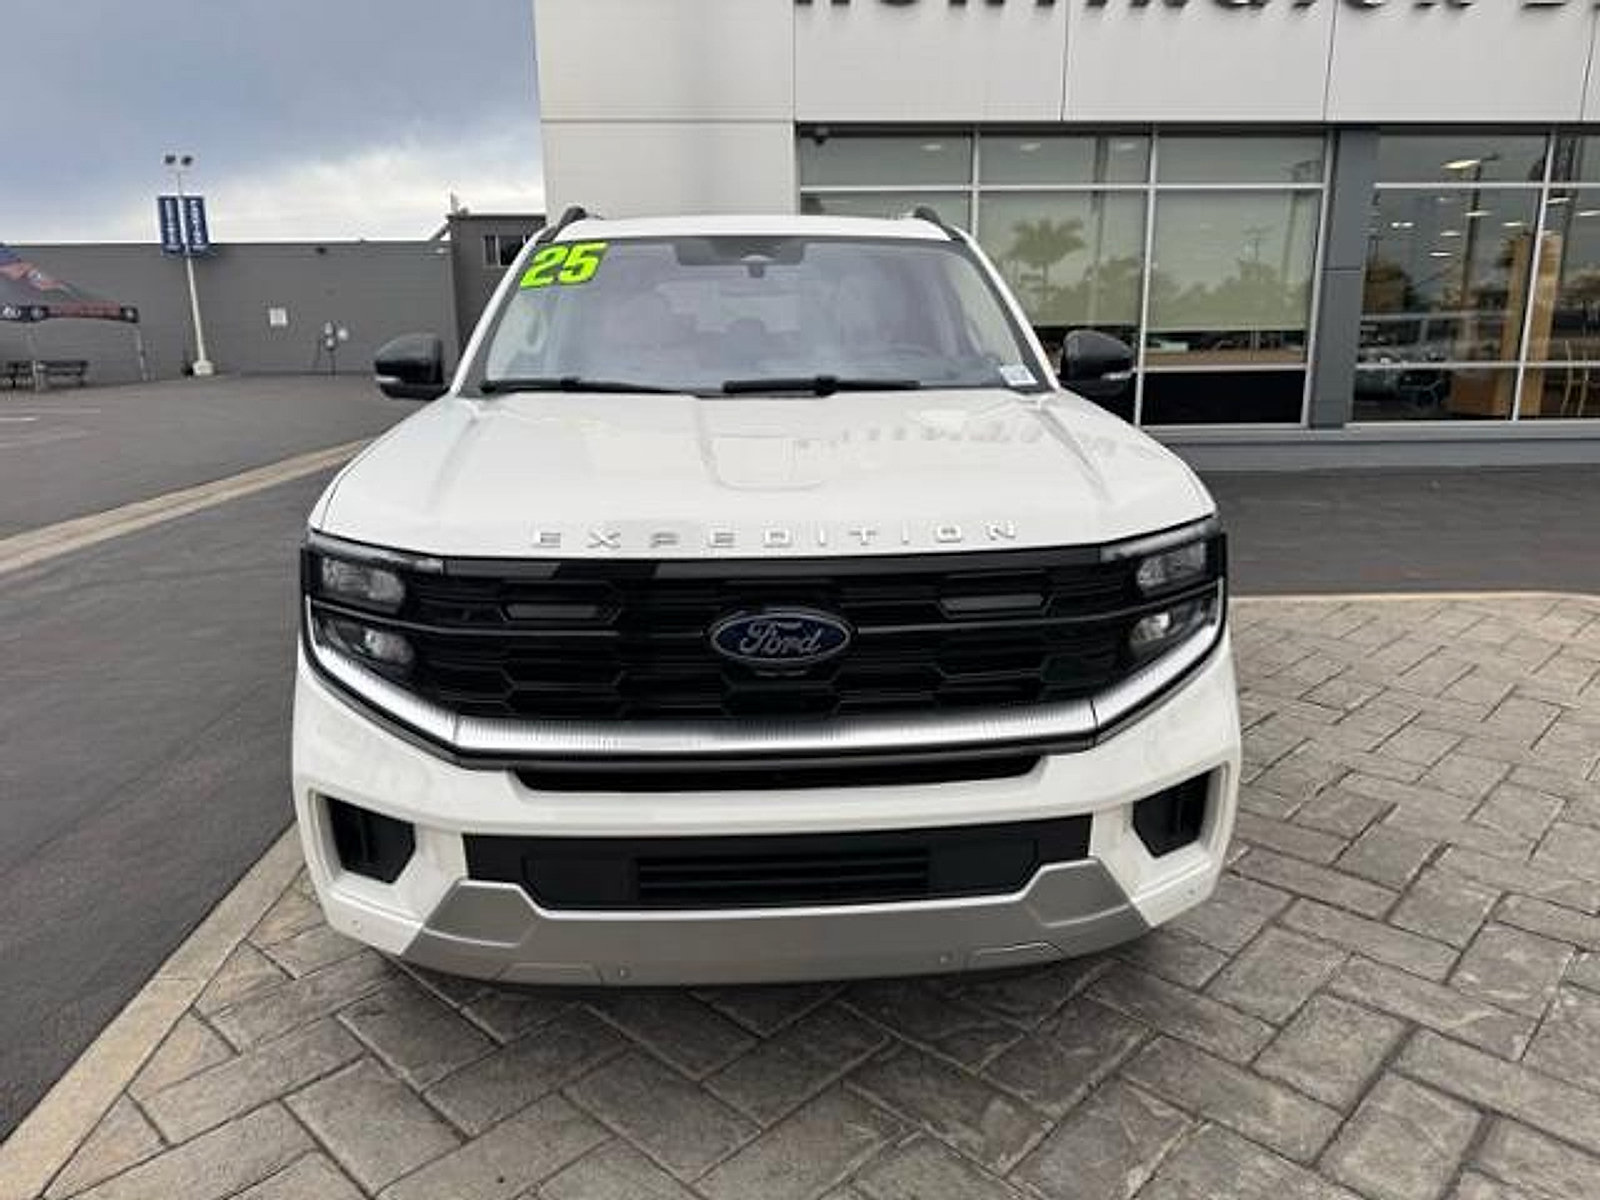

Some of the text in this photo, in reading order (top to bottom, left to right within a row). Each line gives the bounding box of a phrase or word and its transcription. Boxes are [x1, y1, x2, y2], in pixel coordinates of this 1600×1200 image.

[520, 242, 607, 286] 25
[533, 520, 1018, 549] EXPEDITION
[739, 620, 823, 655] Ford
